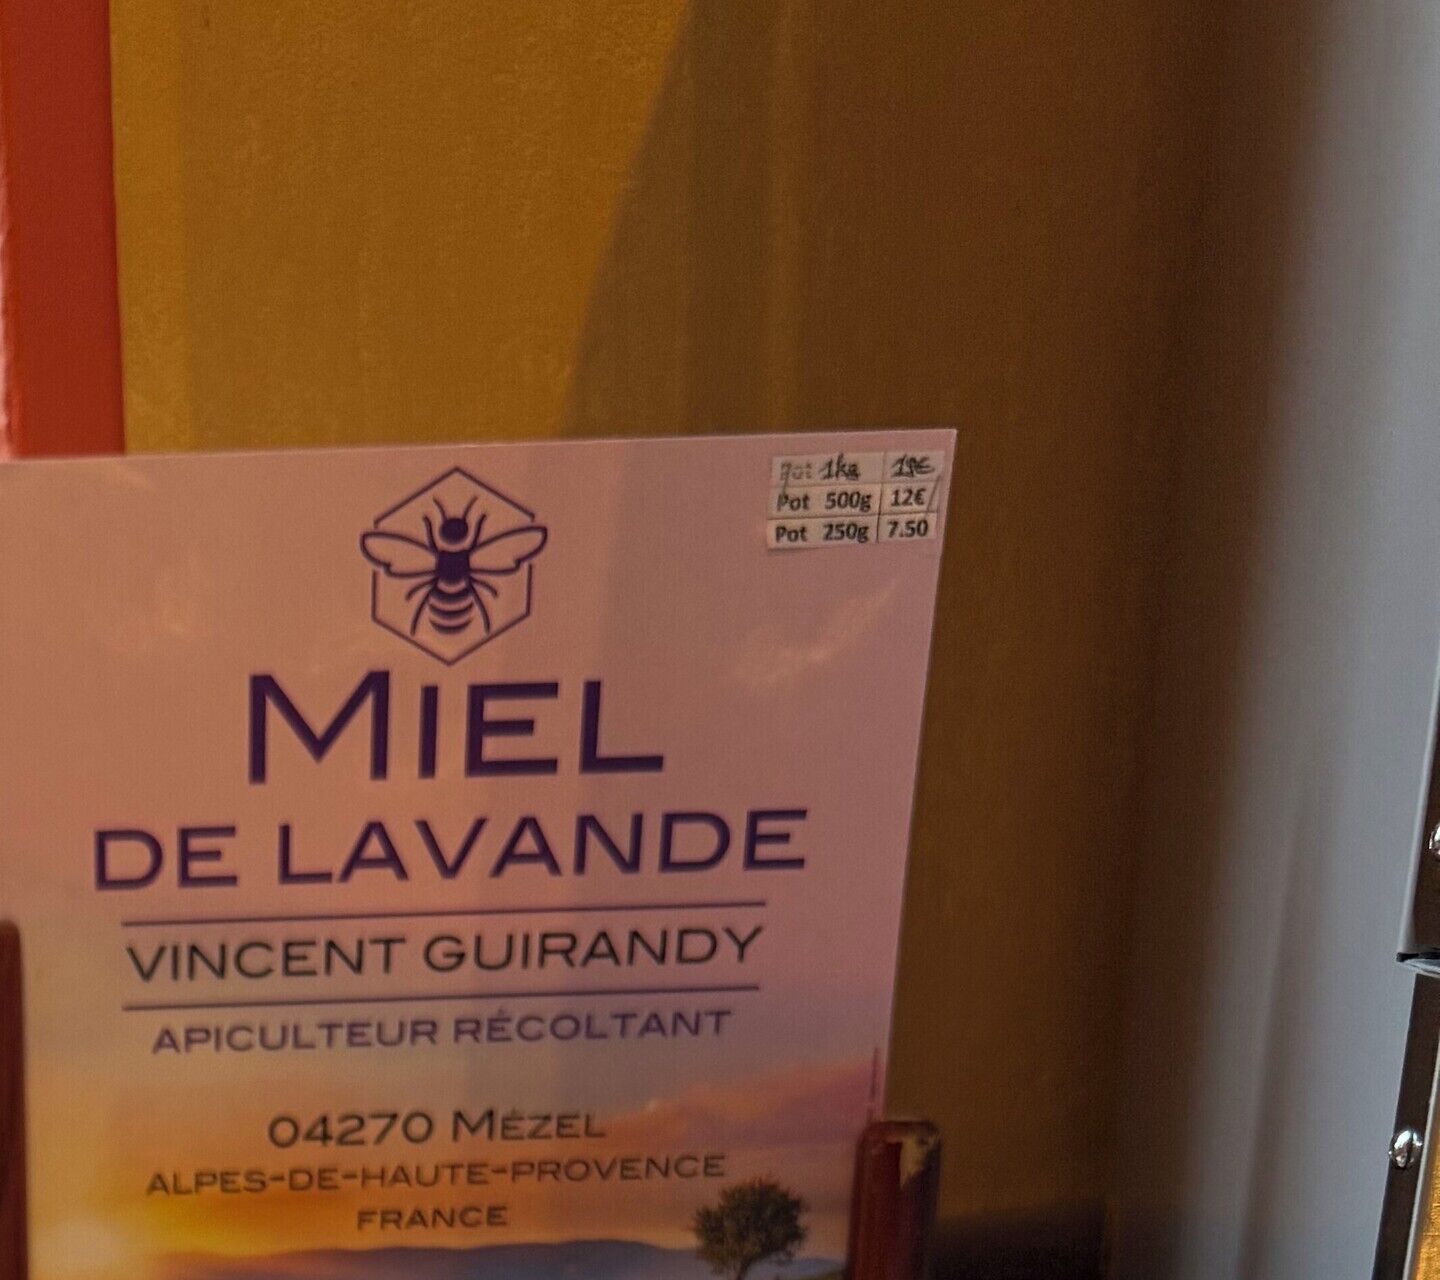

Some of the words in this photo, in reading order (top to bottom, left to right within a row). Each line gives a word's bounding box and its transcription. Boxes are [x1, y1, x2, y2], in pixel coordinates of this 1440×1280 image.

[777, 494, 810, 512] Pot
[825, 491, 872, 513] 500g
[891, 487, 927, 507] 12€
[775, 525, 808, 543] Pot
[823, 522, 870, 544] 250g
[887, 519, 929, 539] 7.50
[248, 670, 664, 784] MIEL
[94, 826, 239, 892] DE
[277, 808, 808, 886] LAVANDE
[126, 937, 406, 983] VINCENT
[422, 926, 765, 974] GUIRANDY
[152, 1018, 439, 1054] APICULTEUR
[452, 1006, 733, 1046] RÉCOLTANT
[267, 1110, 434, 1149] 04270
[452, 1106, 607, 1143] MÉZEL
[146, 1154, 727, 1198] ALPES-DE-HAUTE-PROVENCE
[357, 1205, 508, 1231] FRANCE
